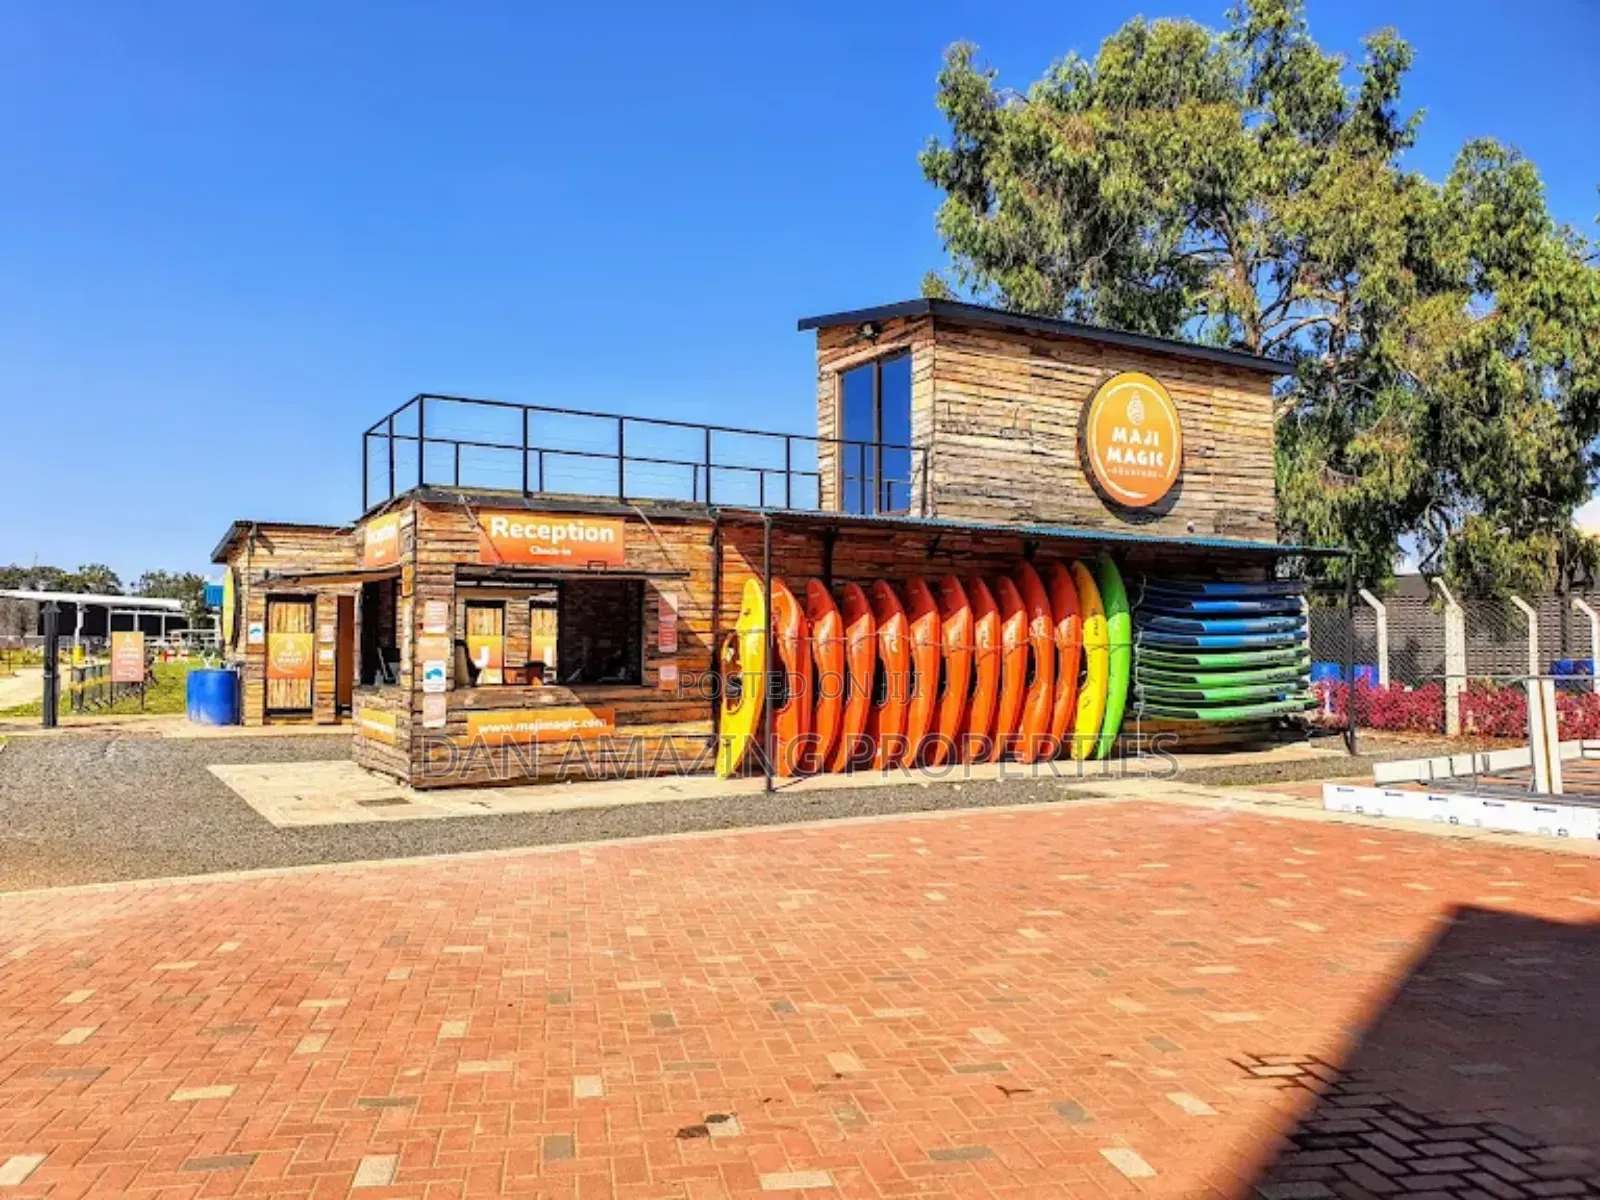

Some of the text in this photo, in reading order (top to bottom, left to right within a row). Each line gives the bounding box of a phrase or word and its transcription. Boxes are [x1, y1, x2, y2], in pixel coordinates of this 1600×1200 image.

[1112, 427, 1160, 446] MAJI
[1107, 446, 1163, 467] MAGIC
[490, 516, 615, 544] Reception
